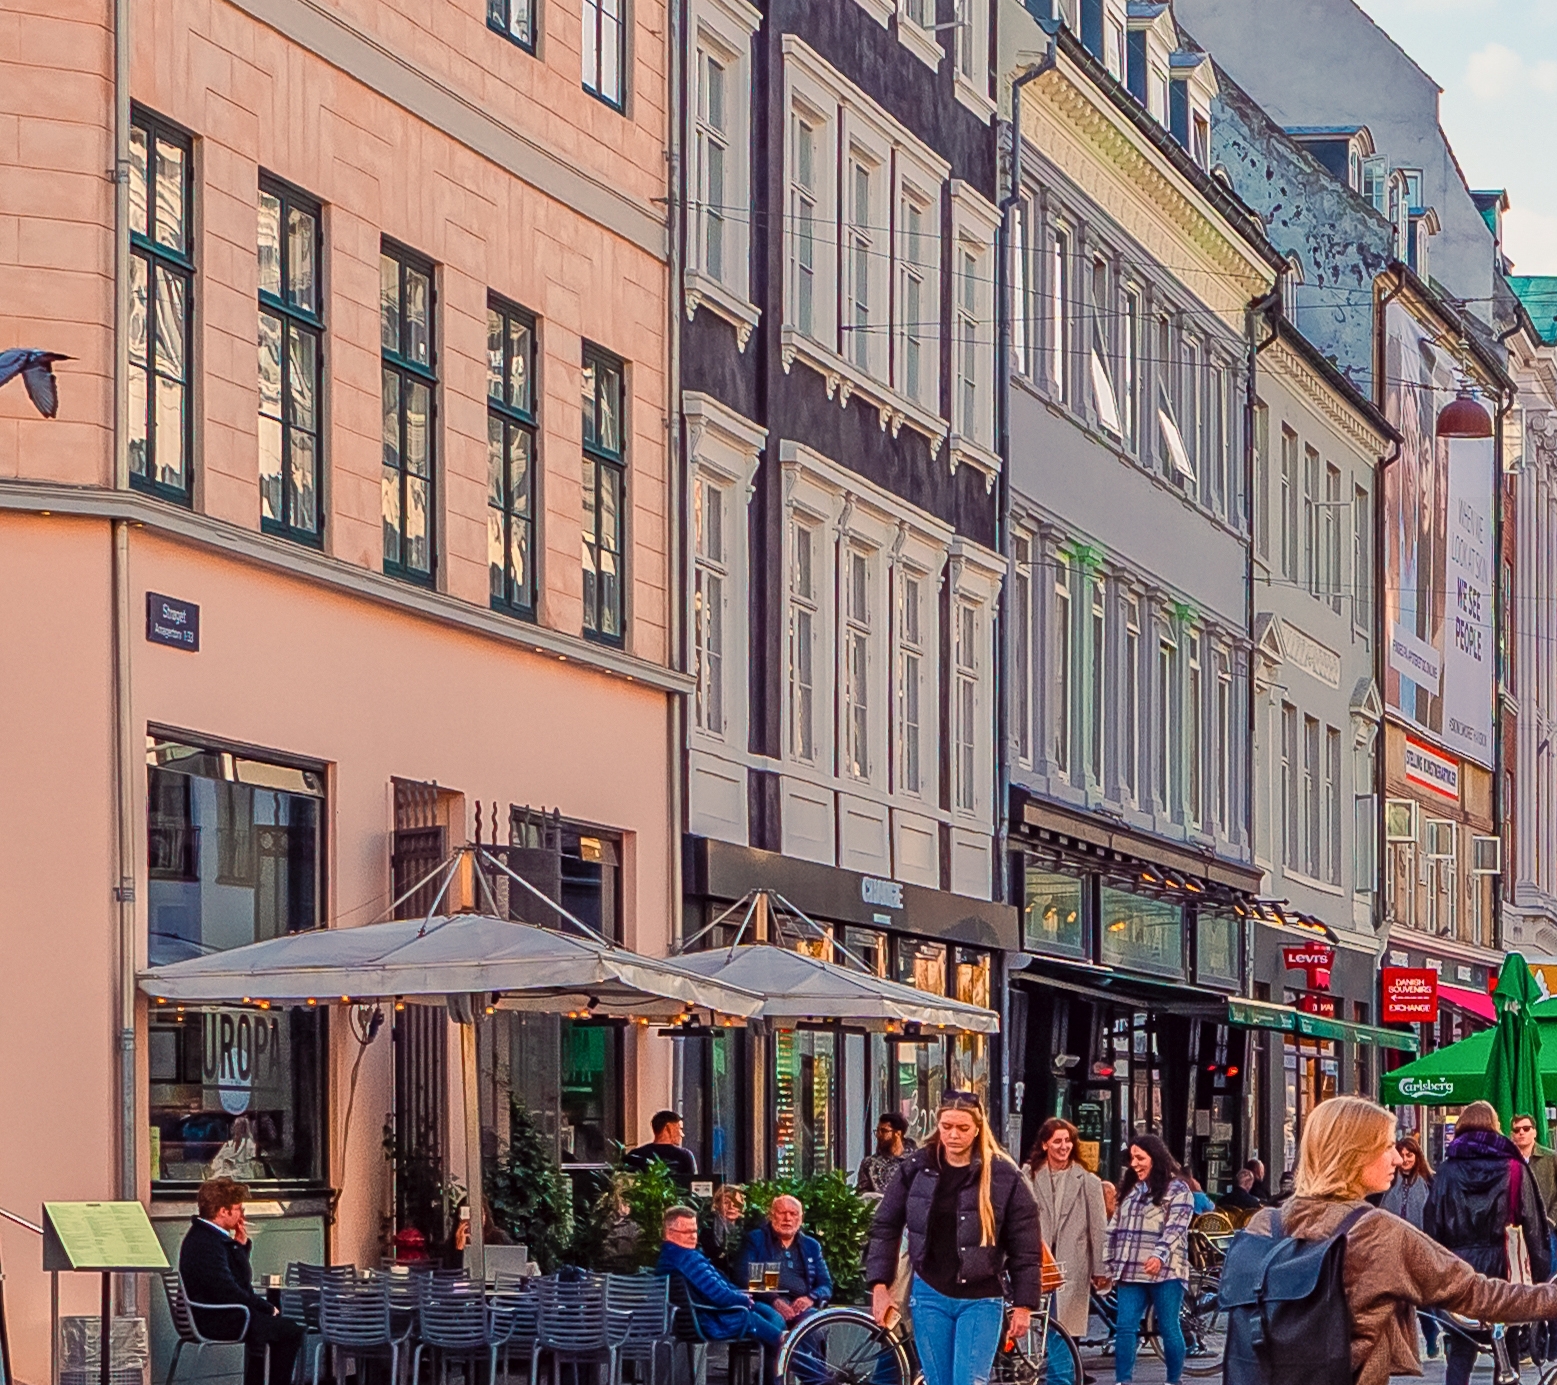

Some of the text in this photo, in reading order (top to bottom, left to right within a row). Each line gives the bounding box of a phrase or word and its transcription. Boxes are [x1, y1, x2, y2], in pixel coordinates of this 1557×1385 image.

[1457, 575, 1481, 622] WE SEE
[1455, 615, 1482, 662] PEOPLE
[1388, 985, 1432, 994] SOUVENIRS
[1395, 978, 1425, 987] DANISH
[1388, 1003, 1431, 1013] EXCHANGE
[1398, 1076, 1454, 1098] Carlsberg
